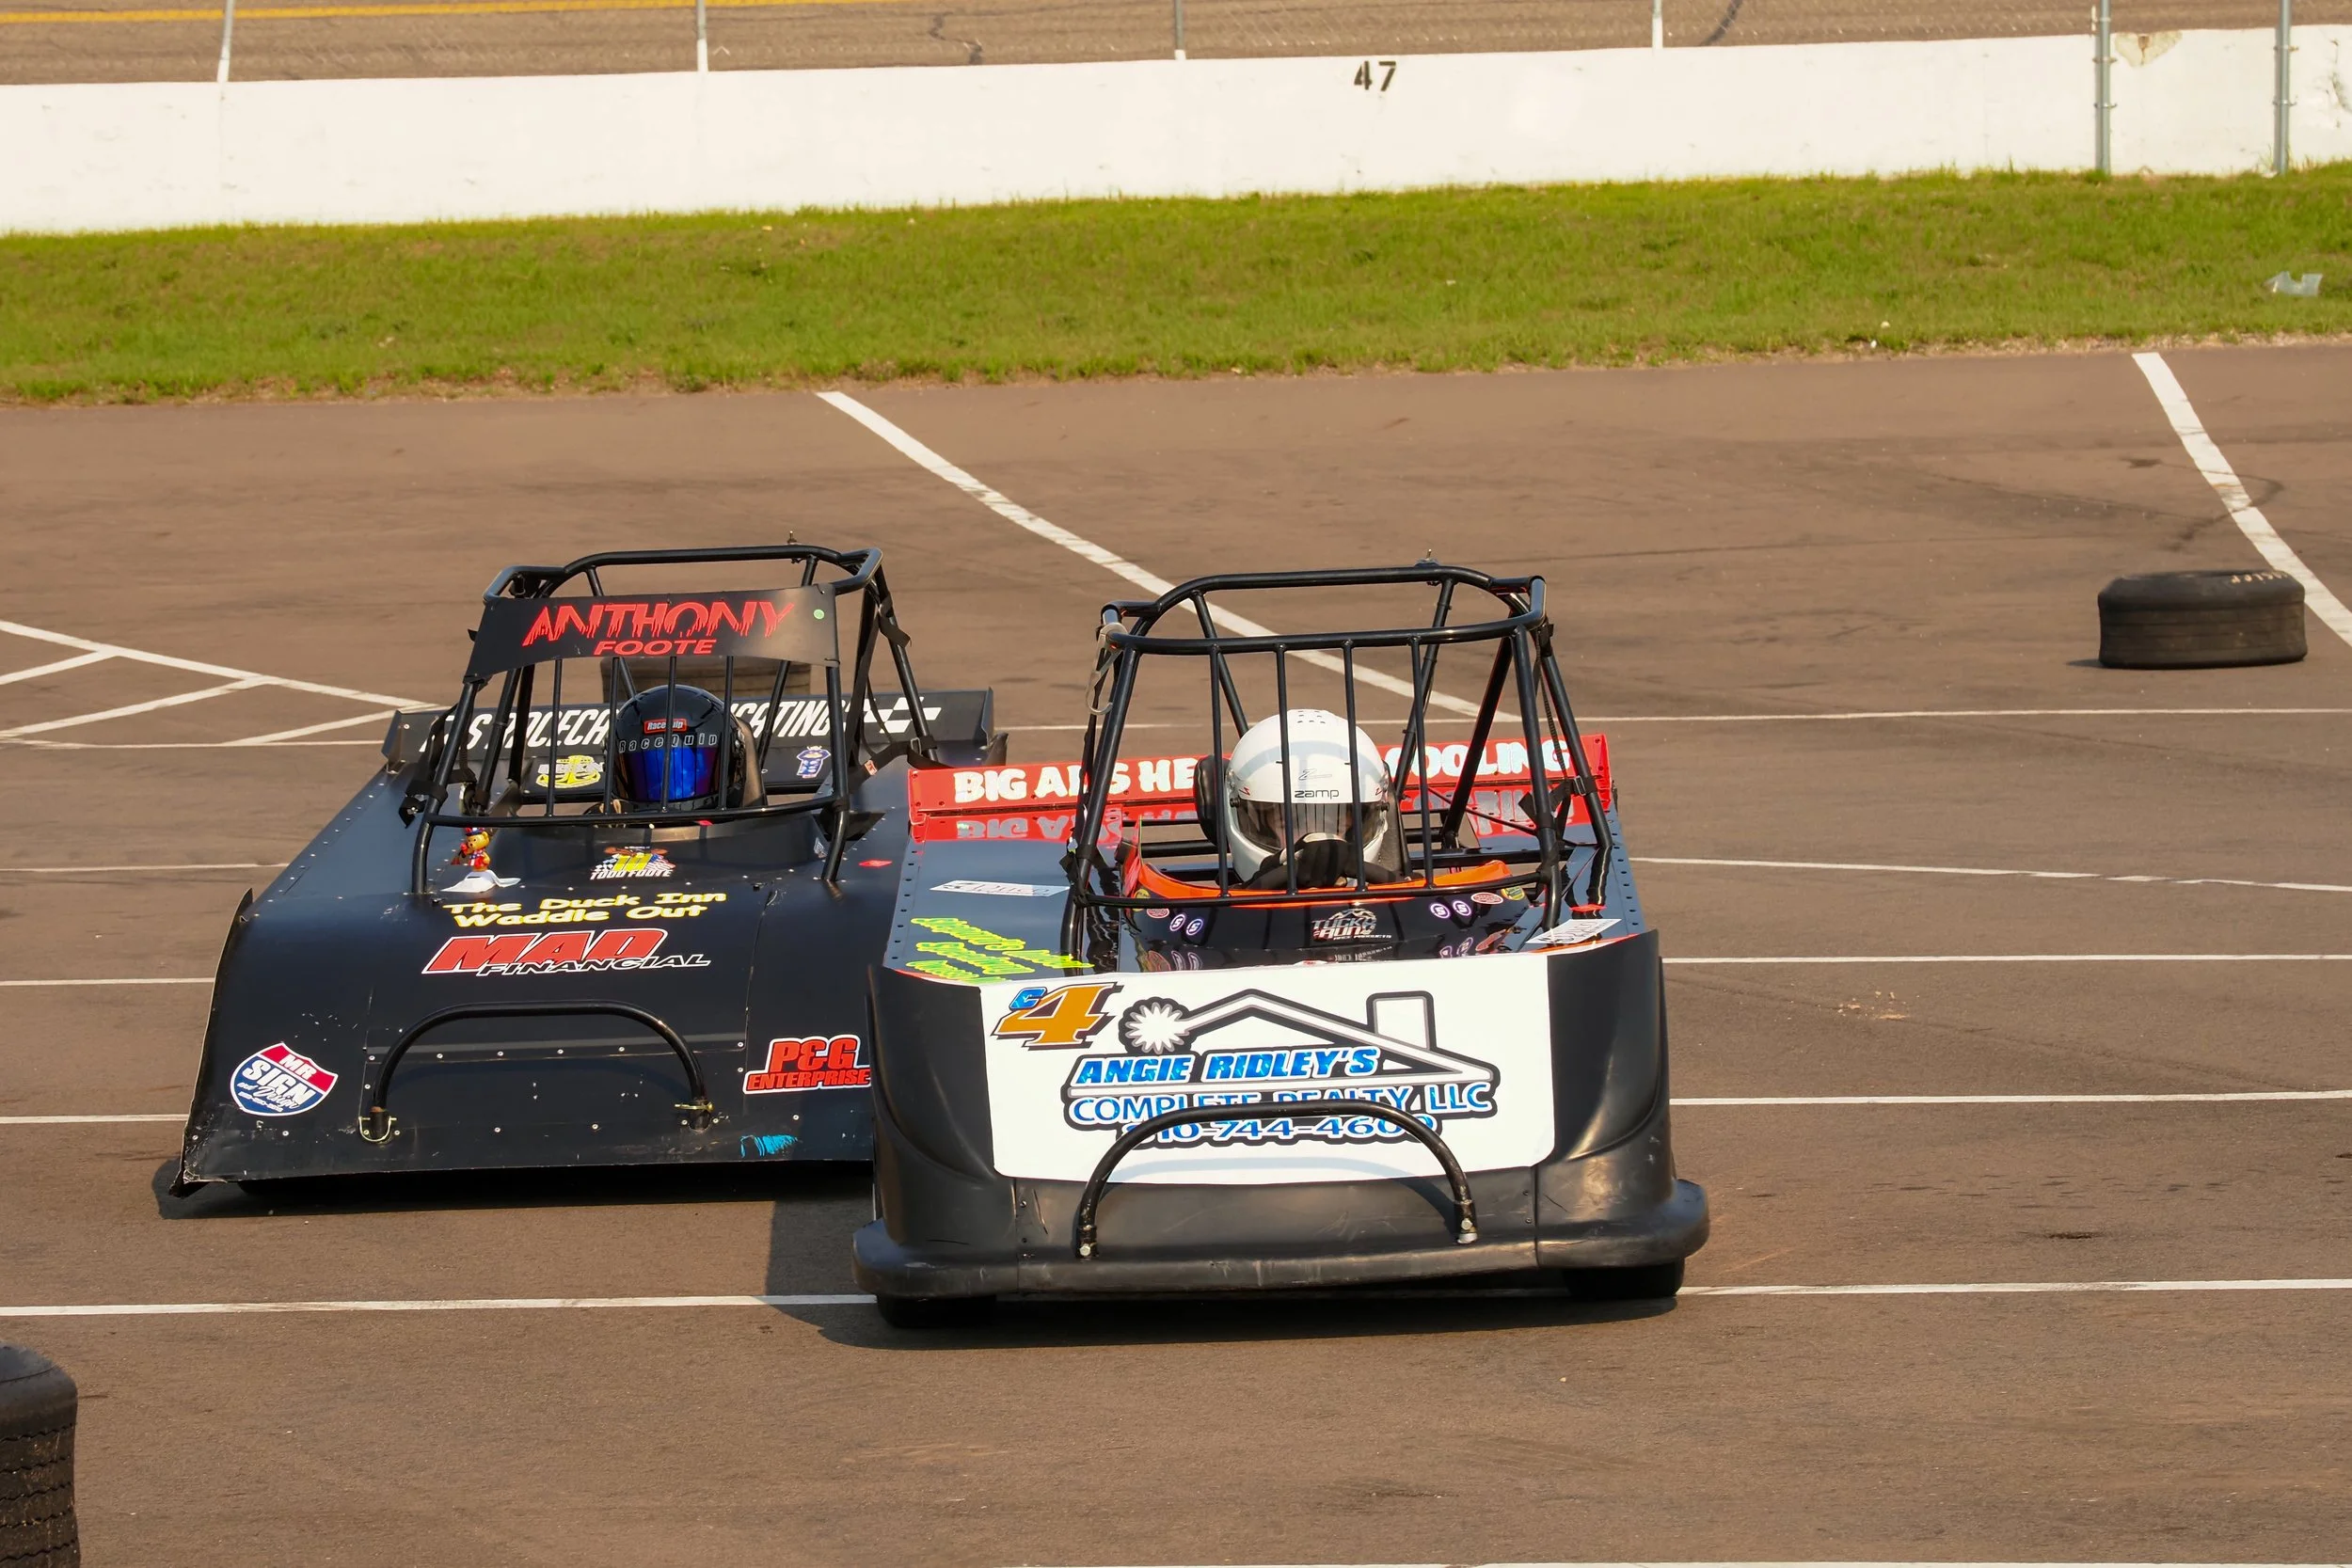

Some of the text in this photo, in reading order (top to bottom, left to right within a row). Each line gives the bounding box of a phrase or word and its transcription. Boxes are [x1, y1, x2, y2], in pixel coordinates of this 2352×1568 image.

[1354, 60, 1396, 91] 47
[521, 600, 795, 647] ANTHONY
[594, 639, 717, 656] FOOTE
[646, 720, 684, 731] Raceuip
[953, 768, 1027, 803] BIG
[1294, 789, 1340, 800] zamp
[443, 892, 727, 914] The Duck Inn
[453, 903, 707, 927] Waddle Out
[421, 928, 668, 974] MAD
[476, 954, 712, 977] FINANCIAL
[278, 1053, 317, 1081] MR
[769, 1037, 858, 1073] P&G
[1075, 1048, 1379, 1085] ANGIE RIDLEY'S
[242, 1059, 317, 1106] SIGN
[1429, 1084, 1489, 1111] LLC
